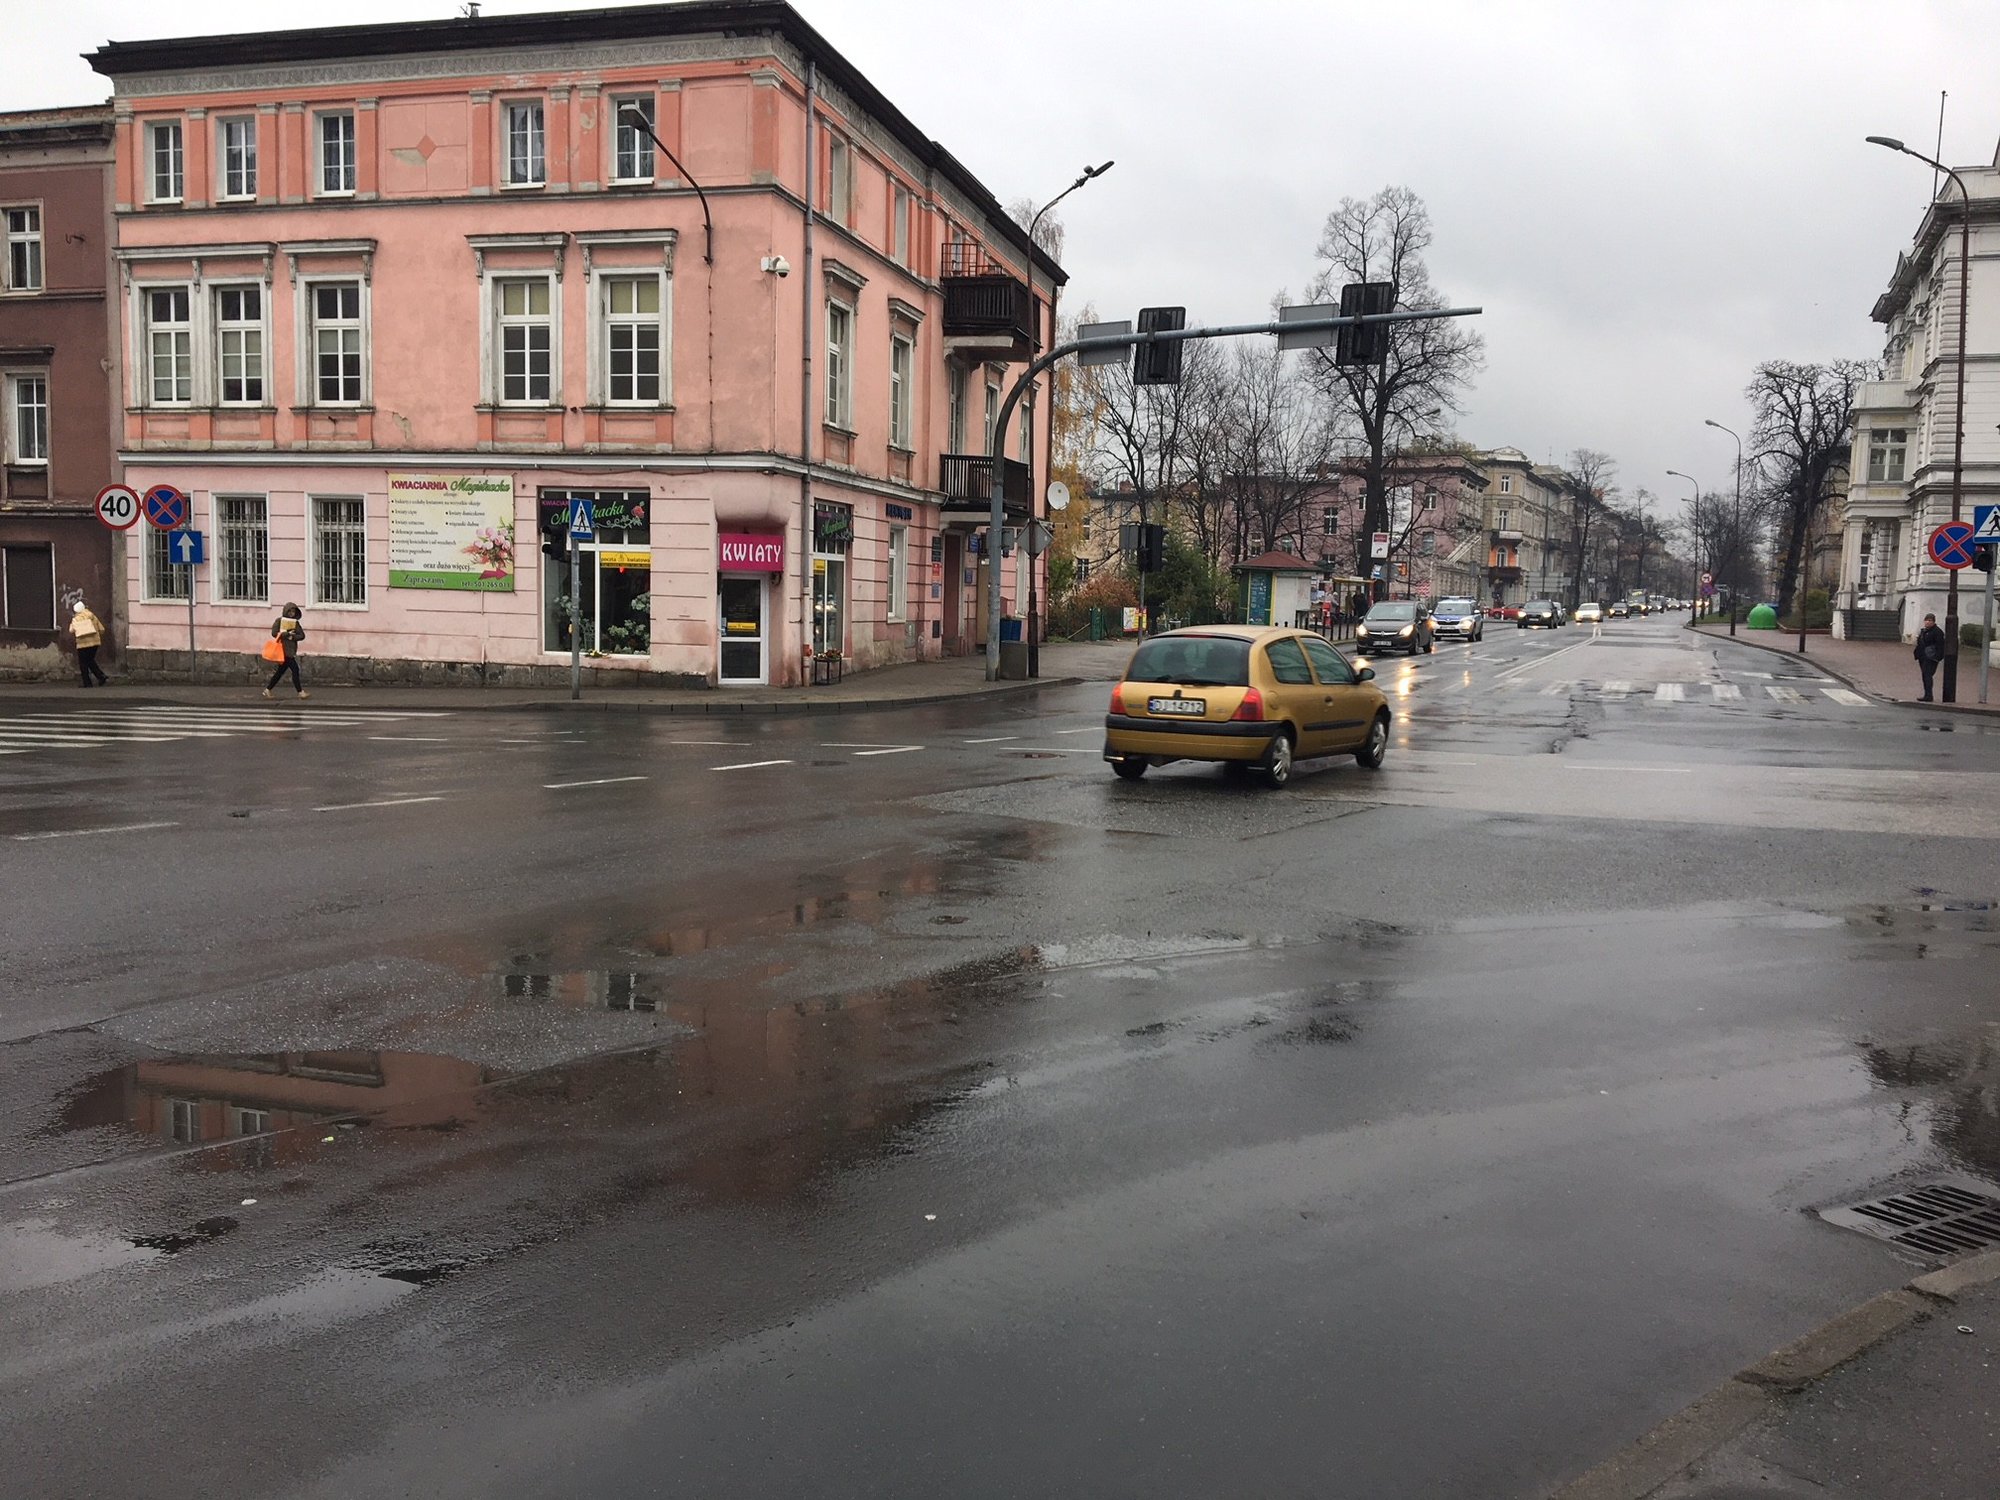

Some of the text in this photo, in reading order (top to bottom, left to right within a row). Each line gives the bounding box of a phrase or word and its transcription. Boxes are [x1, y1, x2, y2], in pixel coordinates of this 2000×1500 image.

[392, 478, 511, 495] KWIACIARNIA Magistracka
[101, 495, 131, 517] 40
[550, 501, 624, 525] Mtracka
[722, 543, 781, 562] KWIATY
[404, 574, 446, 586] Zapraszamy
